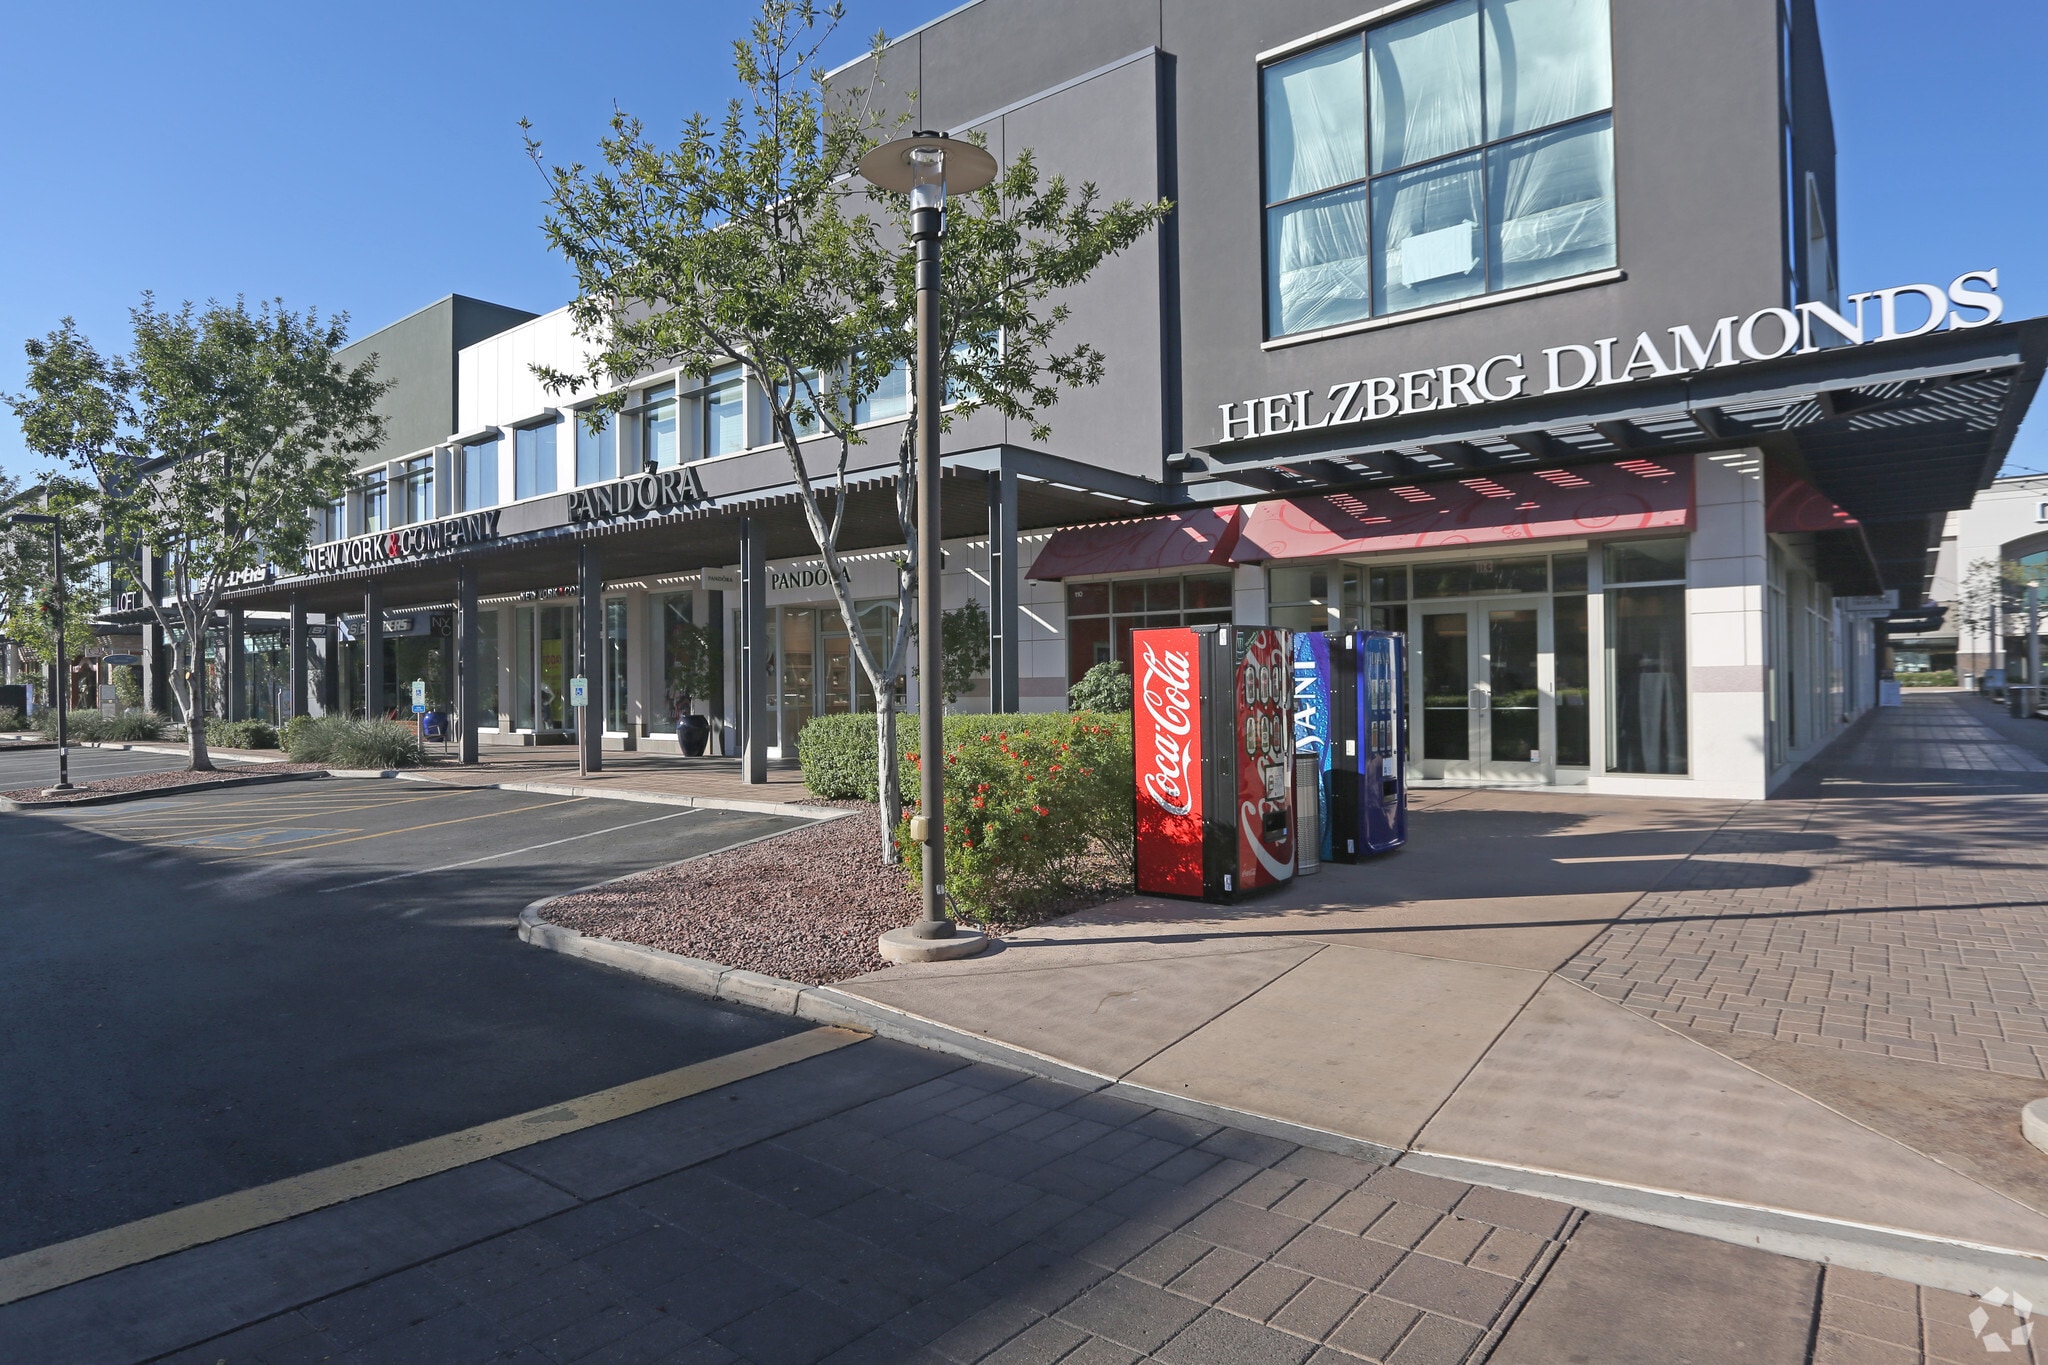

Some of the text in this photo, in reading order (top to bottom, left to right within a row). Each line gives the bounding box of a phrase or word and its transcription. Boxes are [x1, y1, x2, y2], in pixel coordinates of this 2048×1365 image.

[1217, 267, 2004, 444] HELZBERG DIAMONDS
[567, 466, 704, 523] PANDORA
[307, 511, 501, 571] NEW YORK & COMPANY
[118, 592, 136, 611] LOFT
[519, 590, 536, 600] NEW
[540, 587, 558, 600] YORK
[771, 565, 852, 590] PANDOA
[1143, 640, 1192, 816] Coca-Cola
